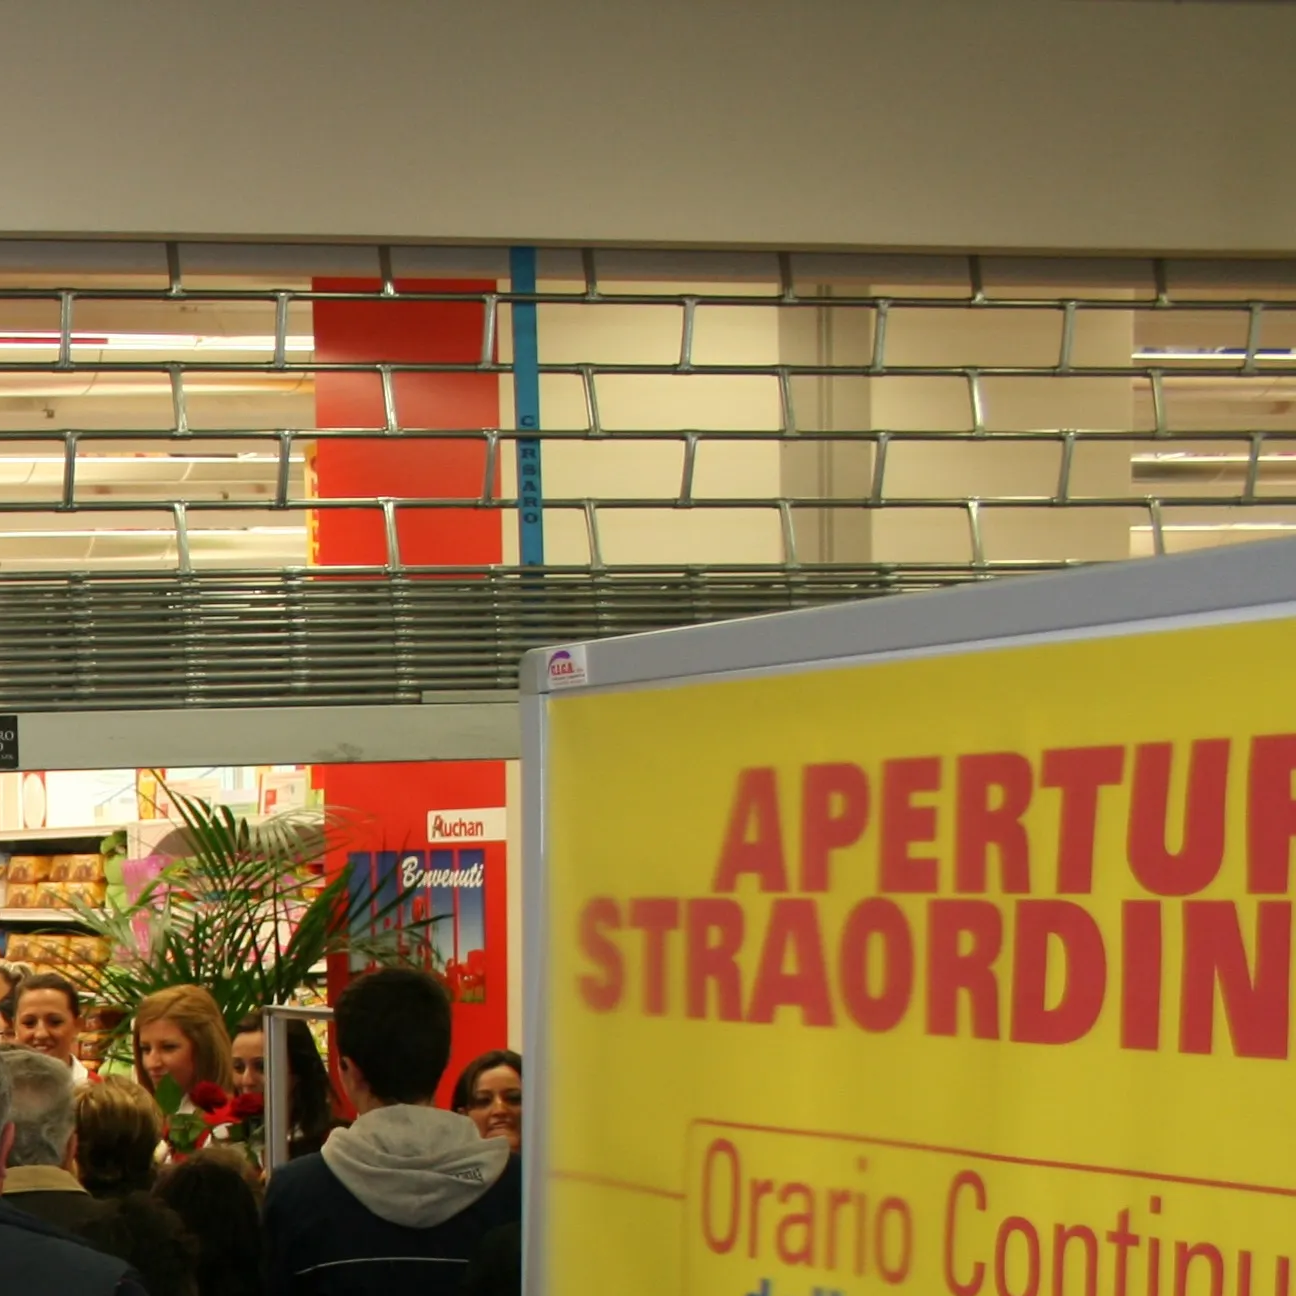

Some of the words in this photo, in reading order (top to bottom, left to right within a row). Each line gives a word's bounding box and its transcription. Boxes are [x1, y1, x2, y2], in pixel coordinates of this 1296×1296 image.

[432, 815, 484, 838] Auchan
[401, 856, 484, 888] Benvenuti
[576, 896, 1293, 1061] STRAORDIN
[701, 1138, 914, 1286] Orario
